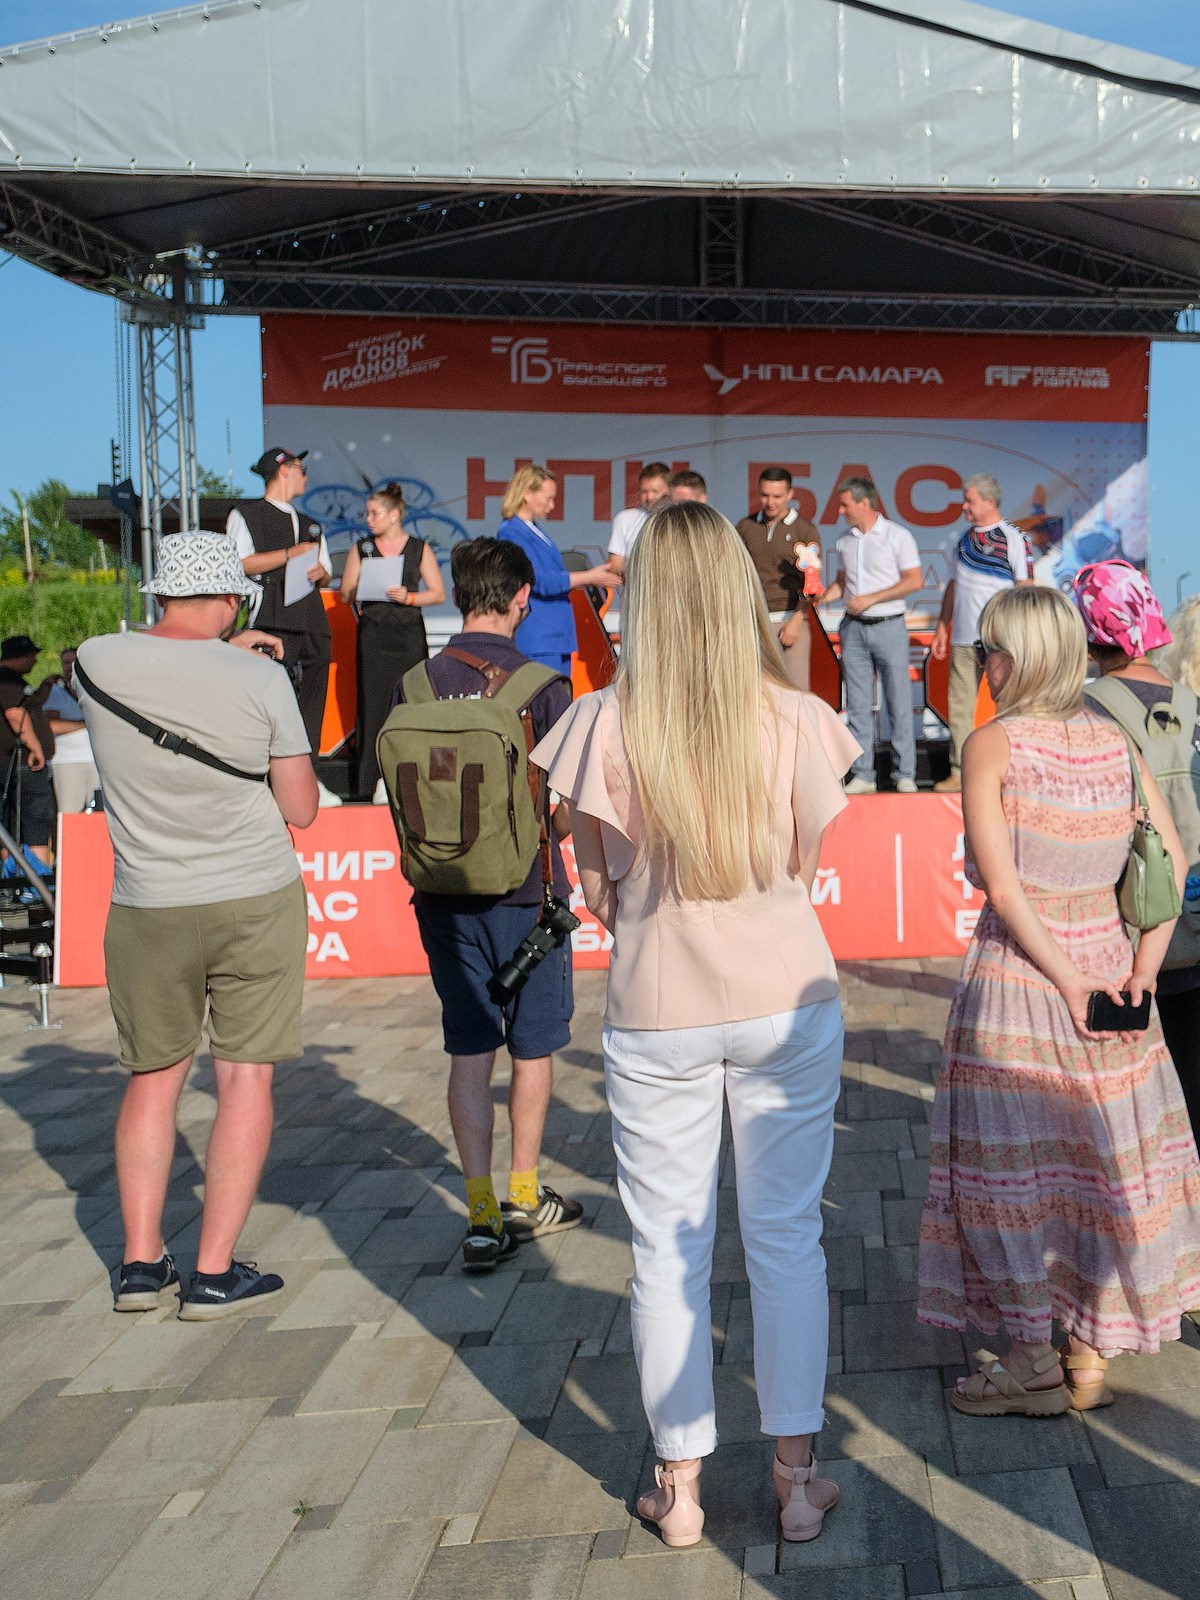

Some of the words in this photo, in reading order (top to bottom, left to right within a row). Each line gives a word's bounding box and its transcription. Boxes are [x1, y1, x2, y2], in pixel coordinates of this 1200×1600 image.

[357, 333, 426, 365] ГОНОК
[322, 353, 409, 392] ДРОНОВ
[743, 364, 810, 381] НПЦ
[814, 365, 944, 385] САМАРА
[296, 851, 395, 881] НИР
[307, 891, 358, 921] АС
